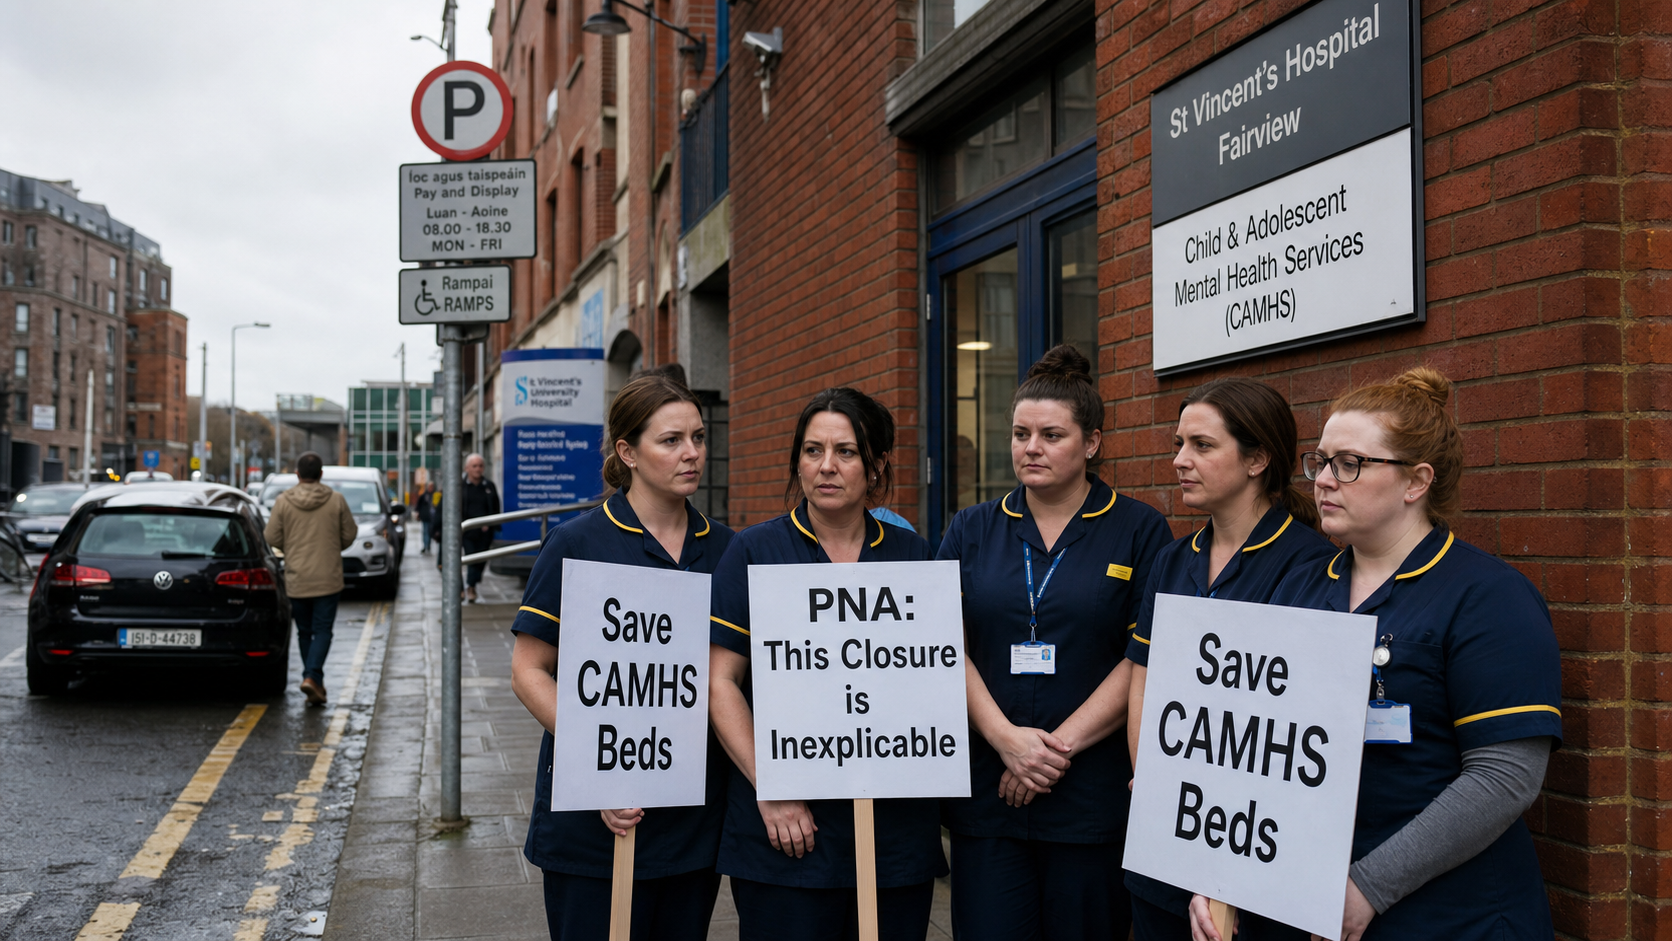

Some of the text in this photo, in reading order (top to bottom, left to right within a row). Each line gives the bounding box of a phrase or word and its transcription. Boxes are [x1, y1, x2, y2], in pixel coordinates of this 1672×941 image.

[1169, 2, 1381, 139] St Vincent's Hospital
[444, 81, 485, 140] P
[1218, 106, 1302, 166] Fairview
[414, 184, 519, 201] Pay and Display
[432, 172, 464, 185] agus
[467, 167, 526, 182] taispeáin
[422, 223, 462, 236] 08.00
[475, 221, 512, 234] 18.30
[426, 207, 457, 219] Luan
[470, 205, 509, 218] Aoine
[1185, 184, 1347, 264] Child & Adolescent
[431, 239, 465, 252] MON
[480, 238, 503, 250] FRI
[442, 275, 494, 291] Rampai
[1174, 231, 1364, 307] Mental Health Services
[443, 296, 494, 313] RAMPS
[1224, 287, 1297, 338] (CAMHS)
[530, 388, 579, 398] University
[530, 398, 573, 408] Hospital
[601, 597, 673, 645] Save
[808, 586, 914, 623] PNA:
[763, 638, 957, 671] This Closure
[1196, 632, 1289, 697] Save
[577, 660, 698, 709] CAMHS
[845, 684, 870, 715] is
[597, 724, 673, 772] Beds
[770, 726, 956, 766] Inexplicable
[1159, 700, 1329, 788] CAMHS
[1174, 781, 1279, 863] Beds
